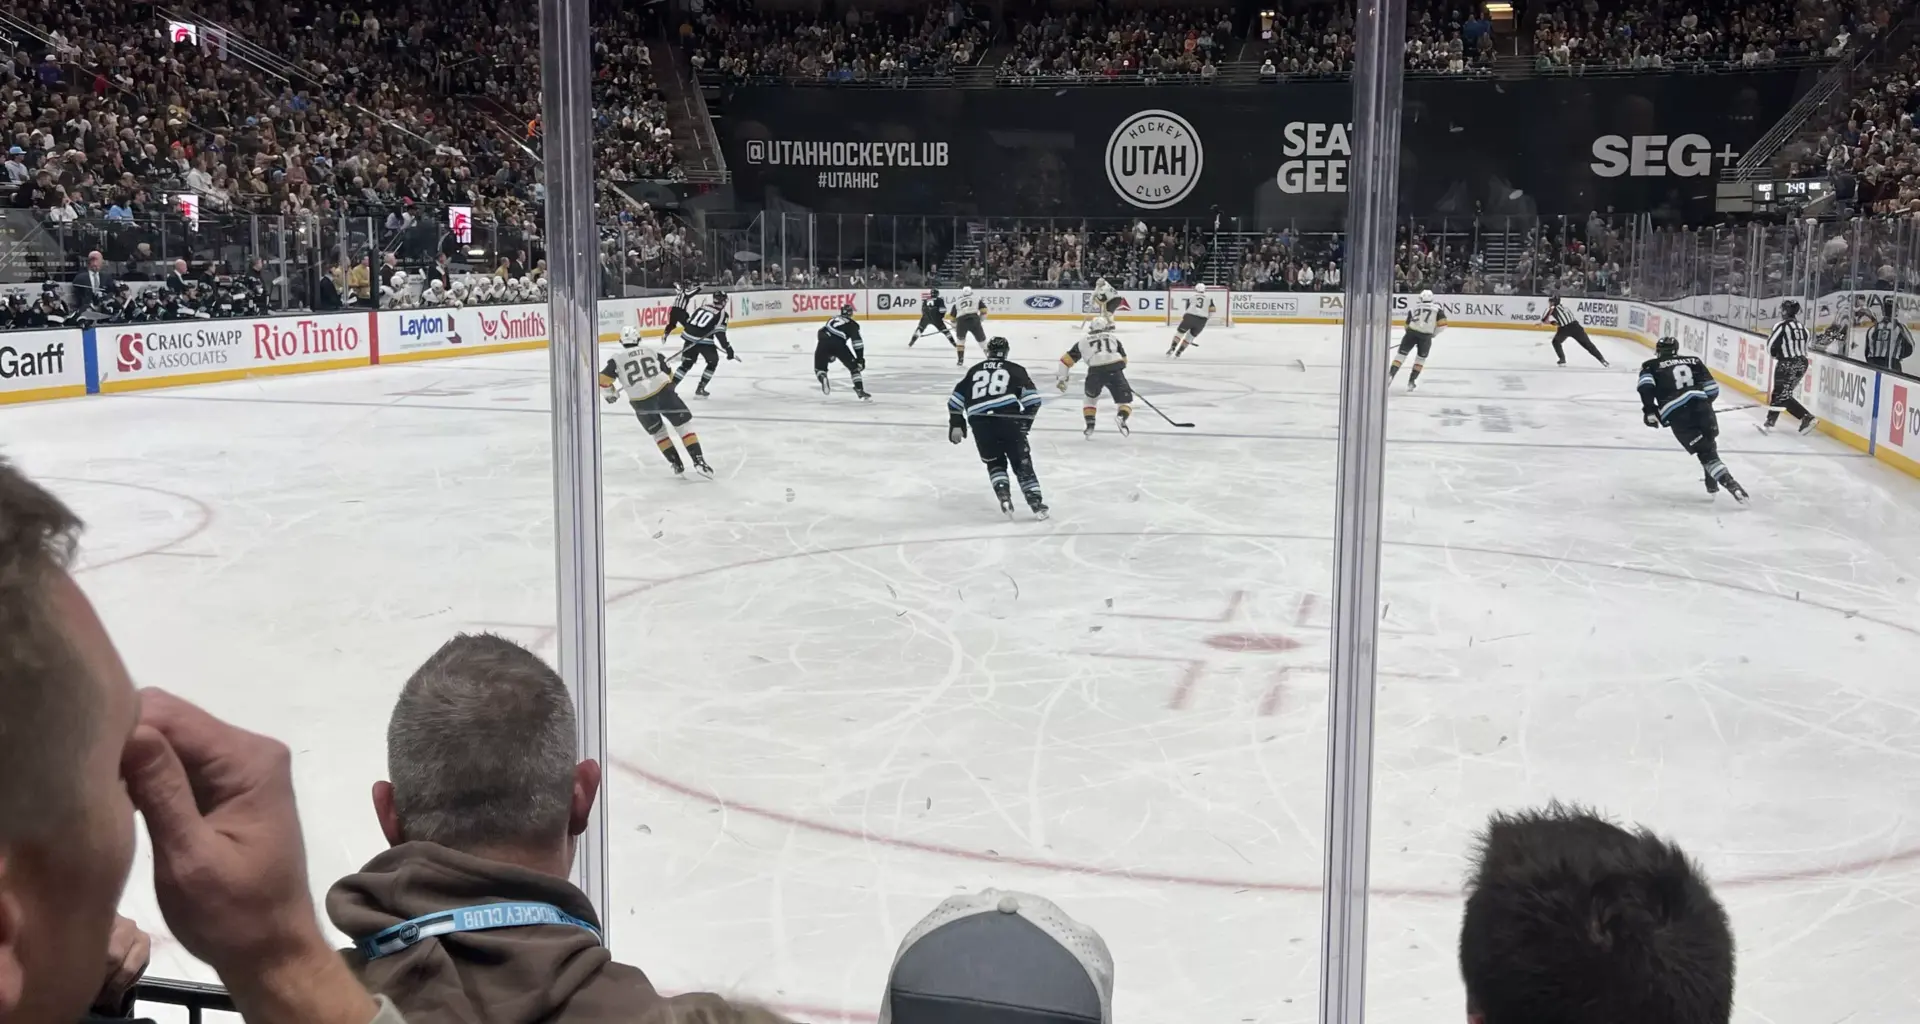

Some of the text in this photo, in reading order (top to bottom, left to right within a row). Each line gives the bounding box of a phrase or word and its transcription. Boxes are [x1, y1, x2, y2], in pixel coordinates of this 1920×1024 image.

[1129, 122, 1182, 139] HOCKEY
[1283, 121, 1352, 157] SEA
[747, 140, 949, 167] @UTAHHOCKEYCLUB
[1122, 145, 1187, 176] UTAH
[1590, 133, 1739, 177] SEG+
[818, 172, 879, 188] #UTAHHC
[1277, 160, 1351, 193] GEE
[1136, 185, 1171, 197] CLUB
[1785, 182, 1806, 193] 7:49
[793, 293, 857, 313] SEATGEEK
[1030, 297, 1056, 308] Ford
[1233, 294, 1253, 302] JUST
[1233, 302, 1296, 311] INGREDIENTS
[1320, 296, 1343, 308] PA
[1393, 297, 1408, 309] IS
[1577, 301, 1618, 315] AMERICAN
[636, 300, 673, 328] veriz
[690, 309, 714, 328] 10
[1412, 308, 1432, 324] 27
[1465, 303, 1505, 316] BANK
[400, 314, 443, 340] Layton
[501, 310, 546, 339] Smith's
[146, 329, 242, 351] CRAIG SWAPP
[0, 343, 65, 379] Garff
[147, 350, 228, 370] & ASSOCIATES
[983, 362, 1004, 370] COLE
[624, 356, 658, 387] 26
[1672, 364, 1694, 390] 8
[971, 368, 1010, 400] 28
[464, 907, 503, 928] CLUB
[507, 905, 558, 924] HOCKEY
